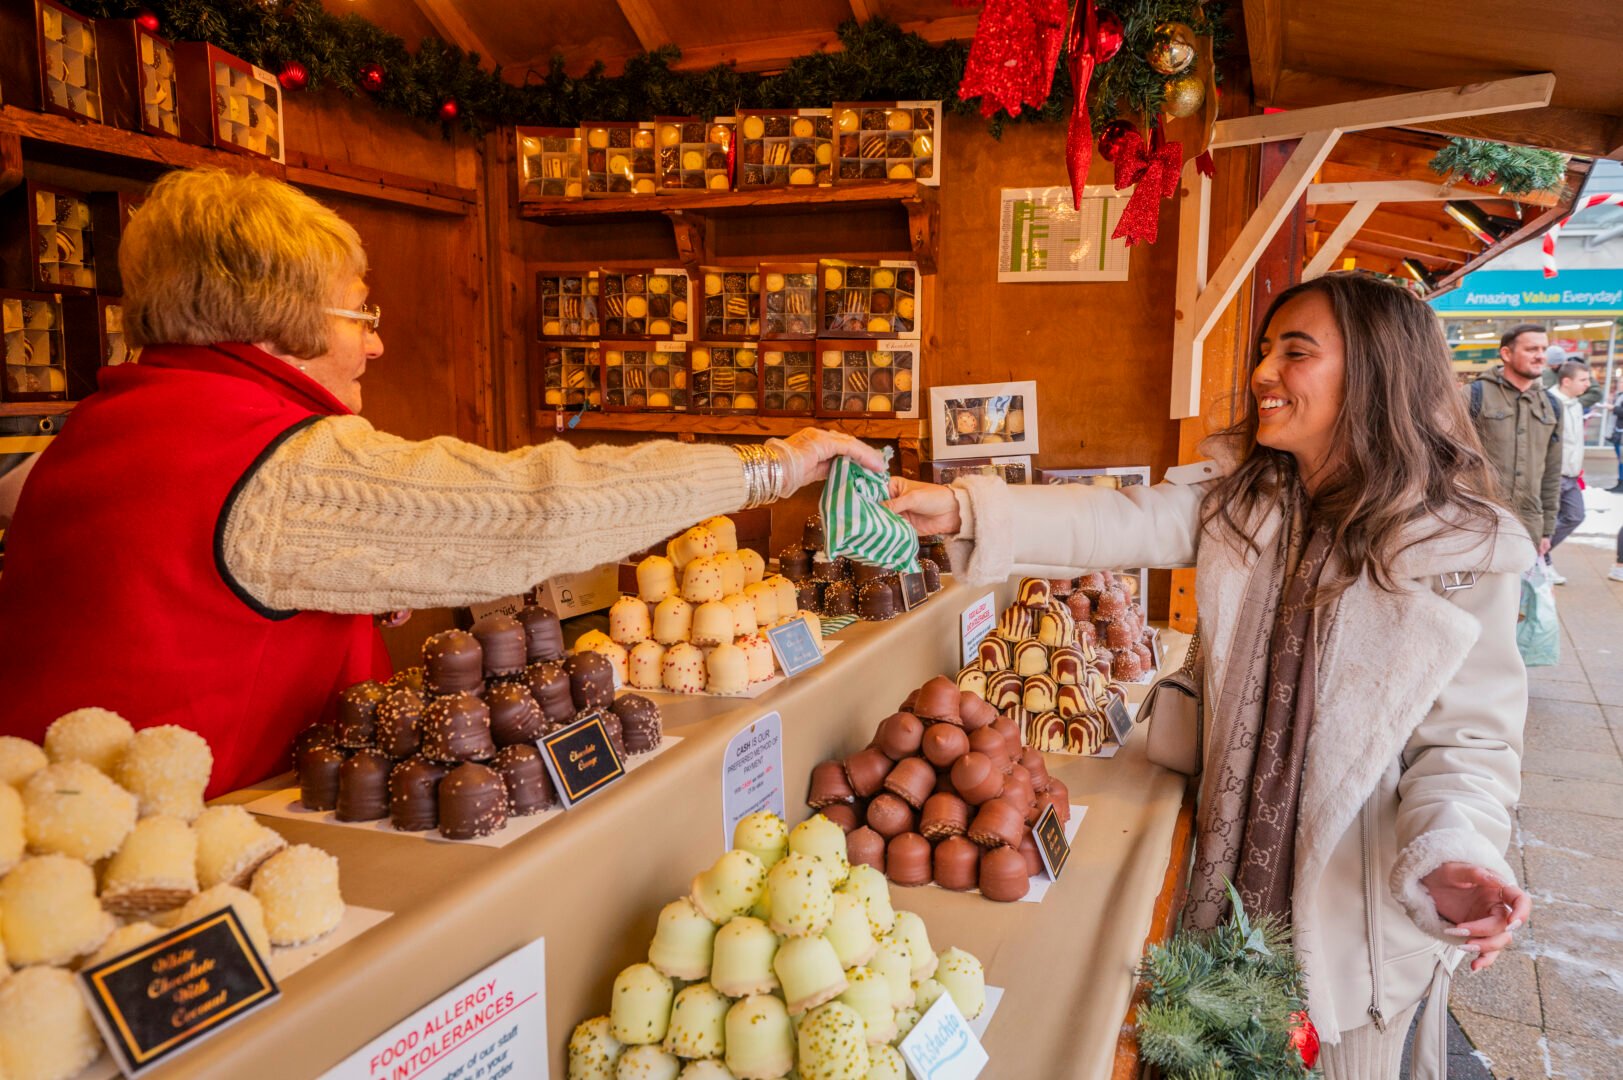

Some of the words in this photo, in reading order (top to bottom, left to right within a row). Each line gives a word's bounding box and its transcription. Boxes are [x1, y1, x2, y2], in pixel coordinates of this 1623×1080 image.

[1465, 292, 1521, 306] Amazing
[1522, 291, 1560, 304] Value
[1562, 290, 1621, 305] Everyday!
[737, 741, 750, 757] CASH
[752, 737, 757, 747] IS
[758, 729, 770, 743] OUR
[147, 958, 216, 999] Chocolate
[369, 1031, 419, 1075] FOOD
[423, 978, 497, 1040] ALLERGY
[392, 990, 514, 1080] INTOLERANCES
[467, 1052, 477, 1068] of
[479, 1043, 496, 1060] our
[498, 1024, 518, 1047] staff
[476, 1067, 485, 1079] in
[487, 1049, 509, 1073] your
